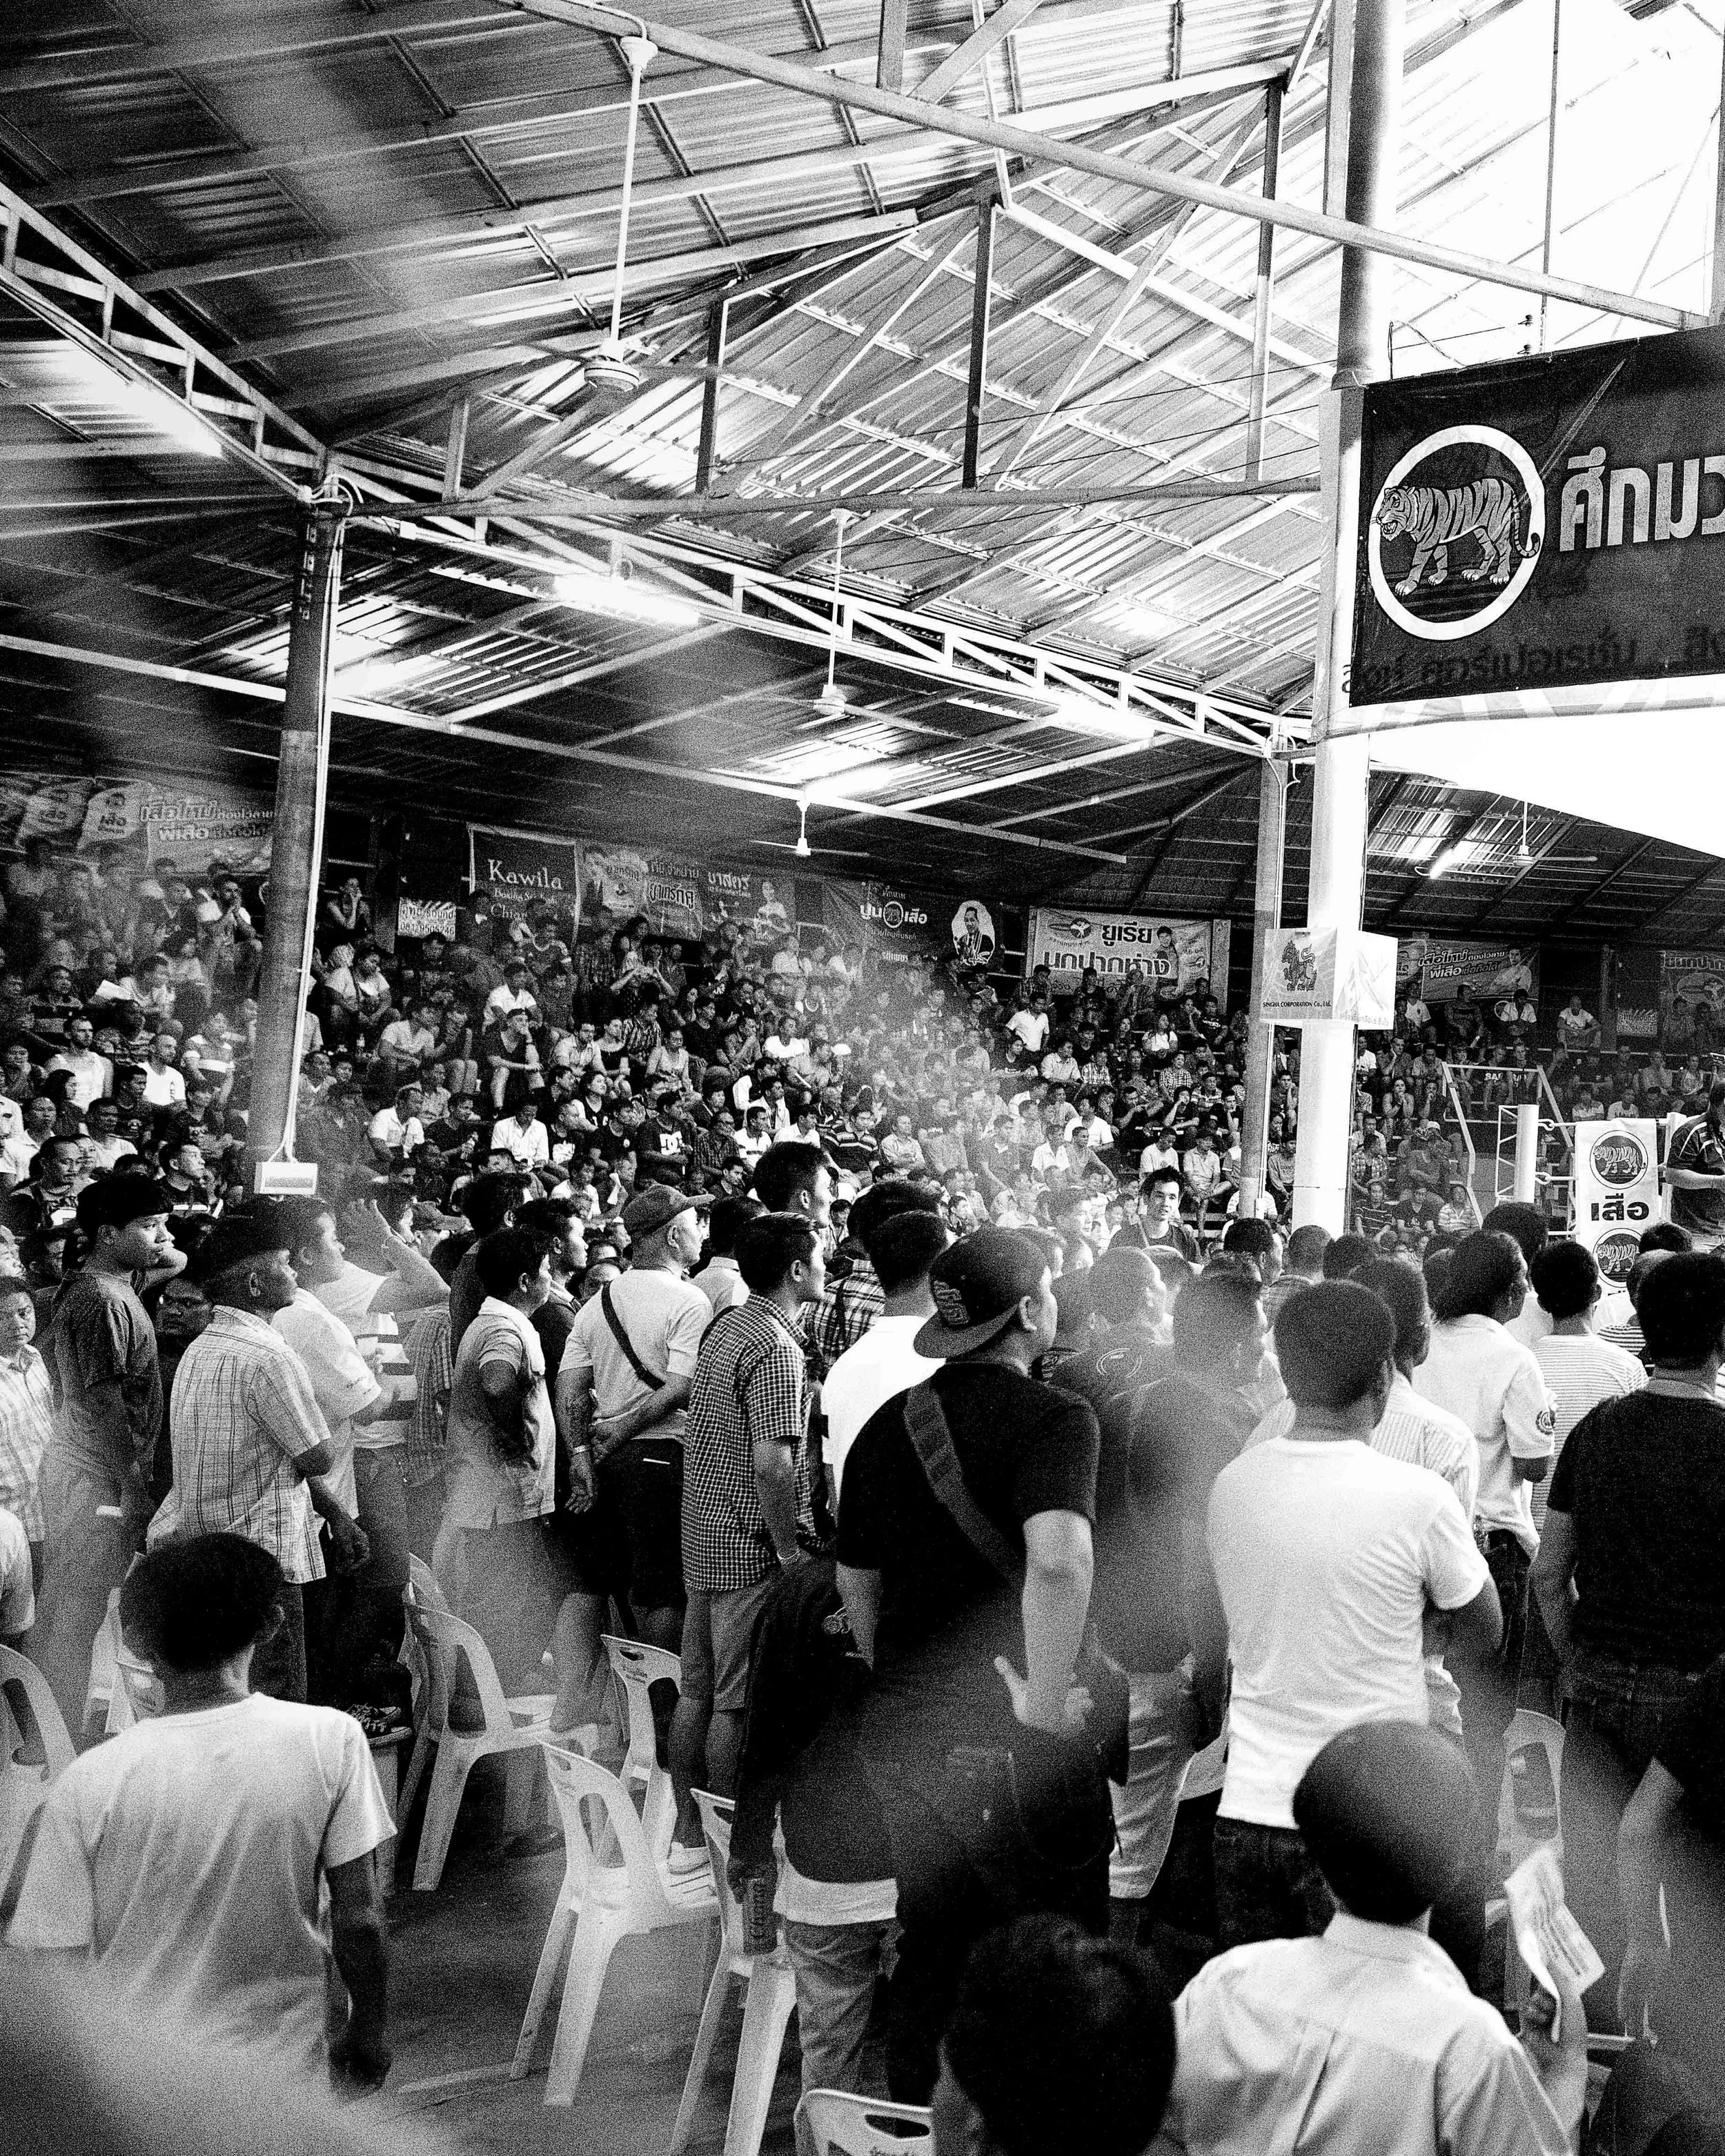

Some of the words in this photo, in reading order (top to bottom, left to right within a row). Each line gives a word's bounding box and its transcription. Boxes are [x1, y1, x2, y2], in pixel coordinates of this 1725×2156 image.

[487, 858, 563, 891] Kawila
[904, 907, 927, 924] เสือ
[1102, 921, 1152, 947] ยูเรีย
[1043, 951, 1172, 977] นกปากห่าง
[1418, 949, 1469, 966] เสือใหม่
[1591, 1193, 1650, 1221] เสือ
